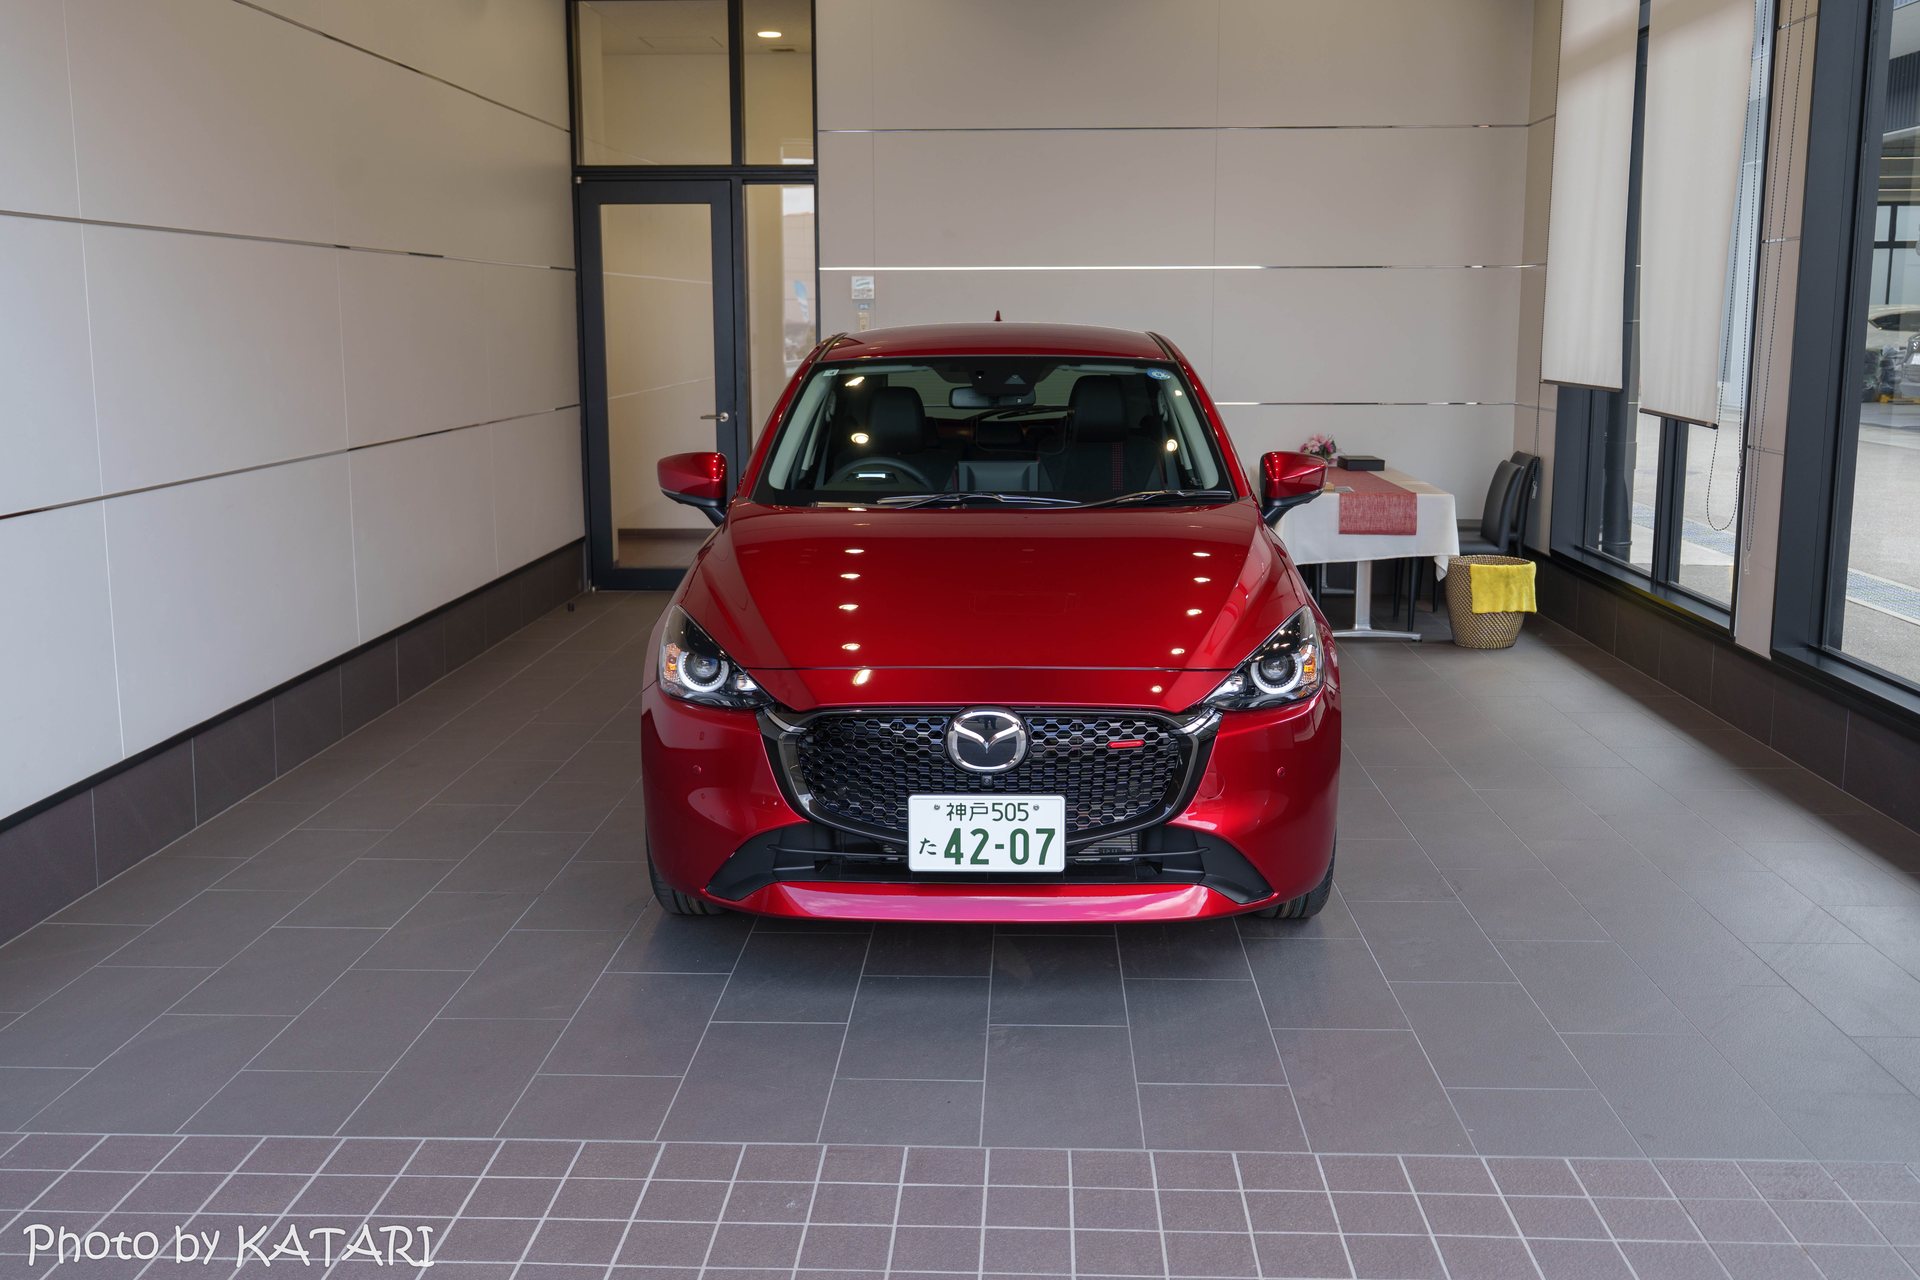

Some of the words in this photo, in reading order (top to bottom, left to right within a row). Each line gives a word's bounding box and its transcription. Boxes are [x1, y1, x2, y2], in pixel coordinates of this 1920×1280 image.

[946, 802, 1029, 822] 神戸505
[919, 838, 937, 855] た
[944, 827, 1056, 866] 42-07
